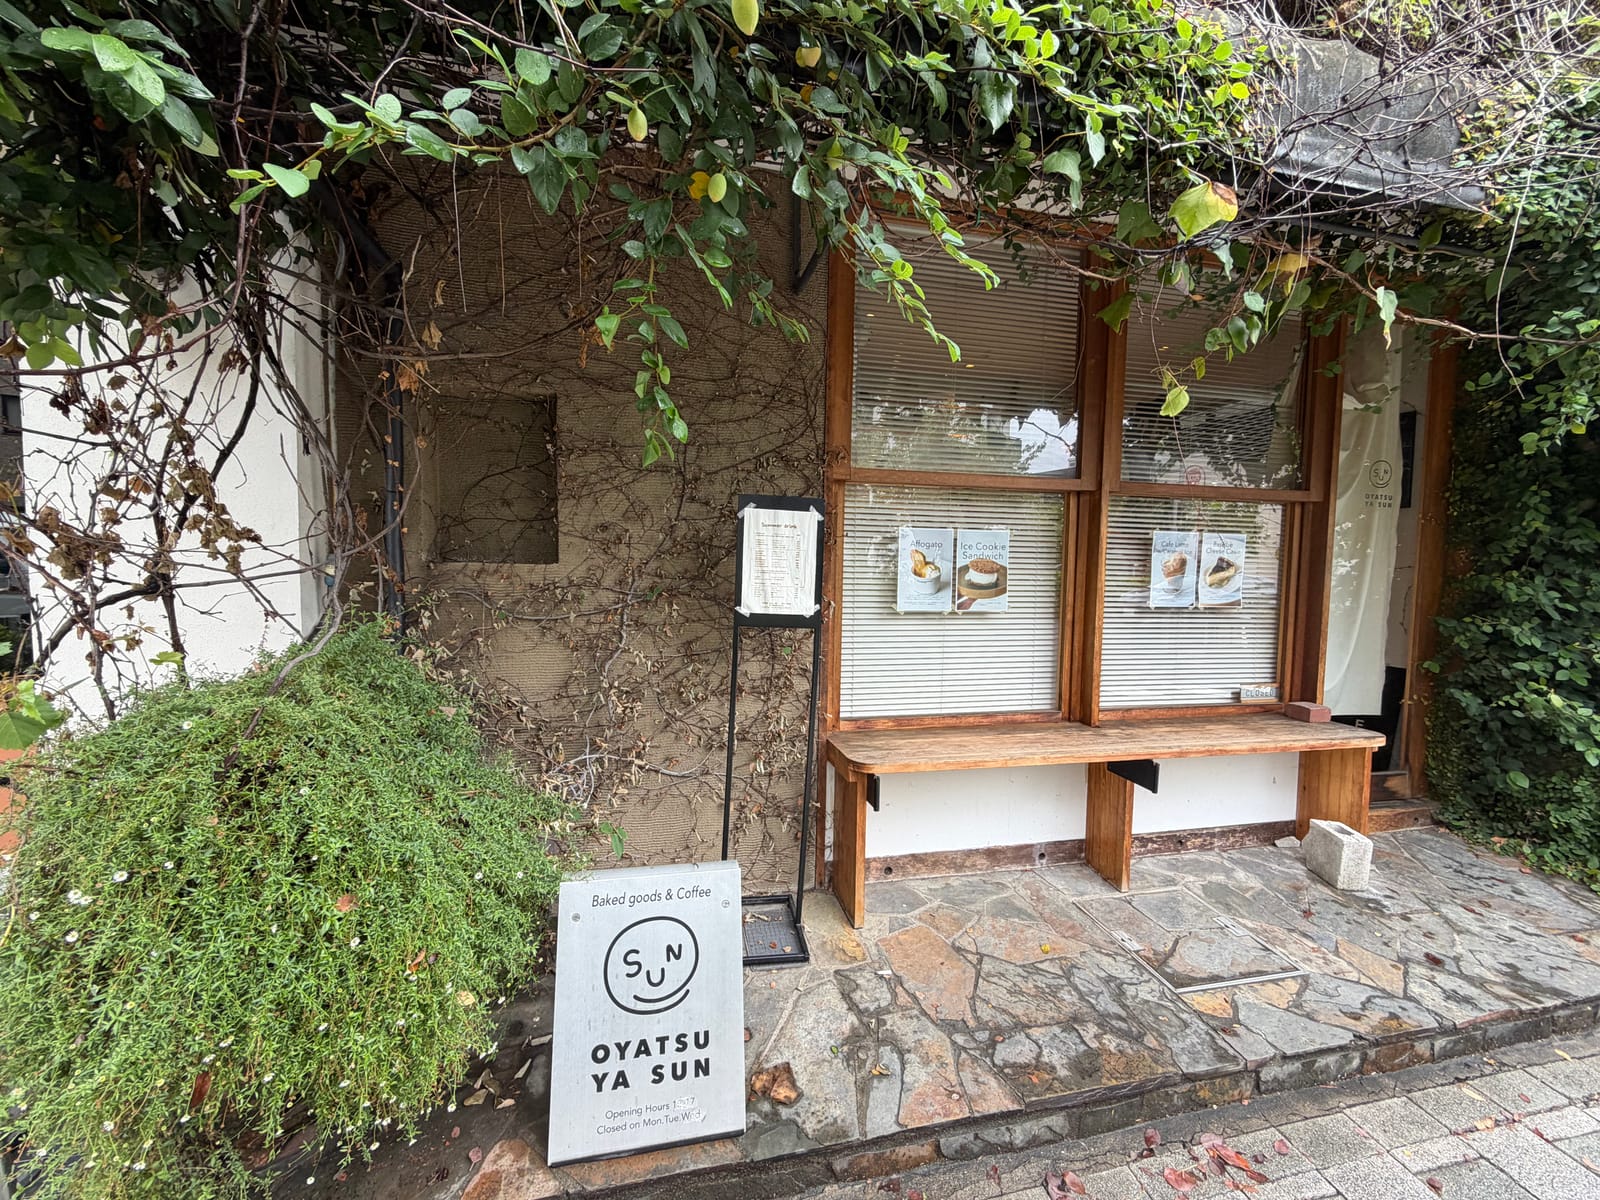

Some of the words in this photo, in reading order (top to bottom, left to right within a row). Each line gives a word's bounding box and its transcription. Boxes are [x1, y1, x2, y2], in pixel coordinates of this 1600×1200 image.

[1365, 493, 1393, 501] OYATSU
[910, 539, 943, 549] Affogato
[960, 542, 973, 550] Ice
[975, 541, 1007, 551] Cookie
[962, 551, 1004, 560] Sandwich
[1245, 688, 1274, 698] CLOSED
[592, 891, 626, 907] Baked
[628, 889, 662, 907] goods
[665, 888, 673, 900] &
[677, 885, 711, 900] Coffee
[591, 1030, 710, 1064] OYATSU
[591, 1069, 630, 1093] YA
[651, 1057, 710, 1084] SUN
[605, 1106, 643, 1121] Opening
[645, 1102, 670, 1113] Hours
[596, 1120, 627, 1135] Closed
[629, 1122, 640, 1130] on
